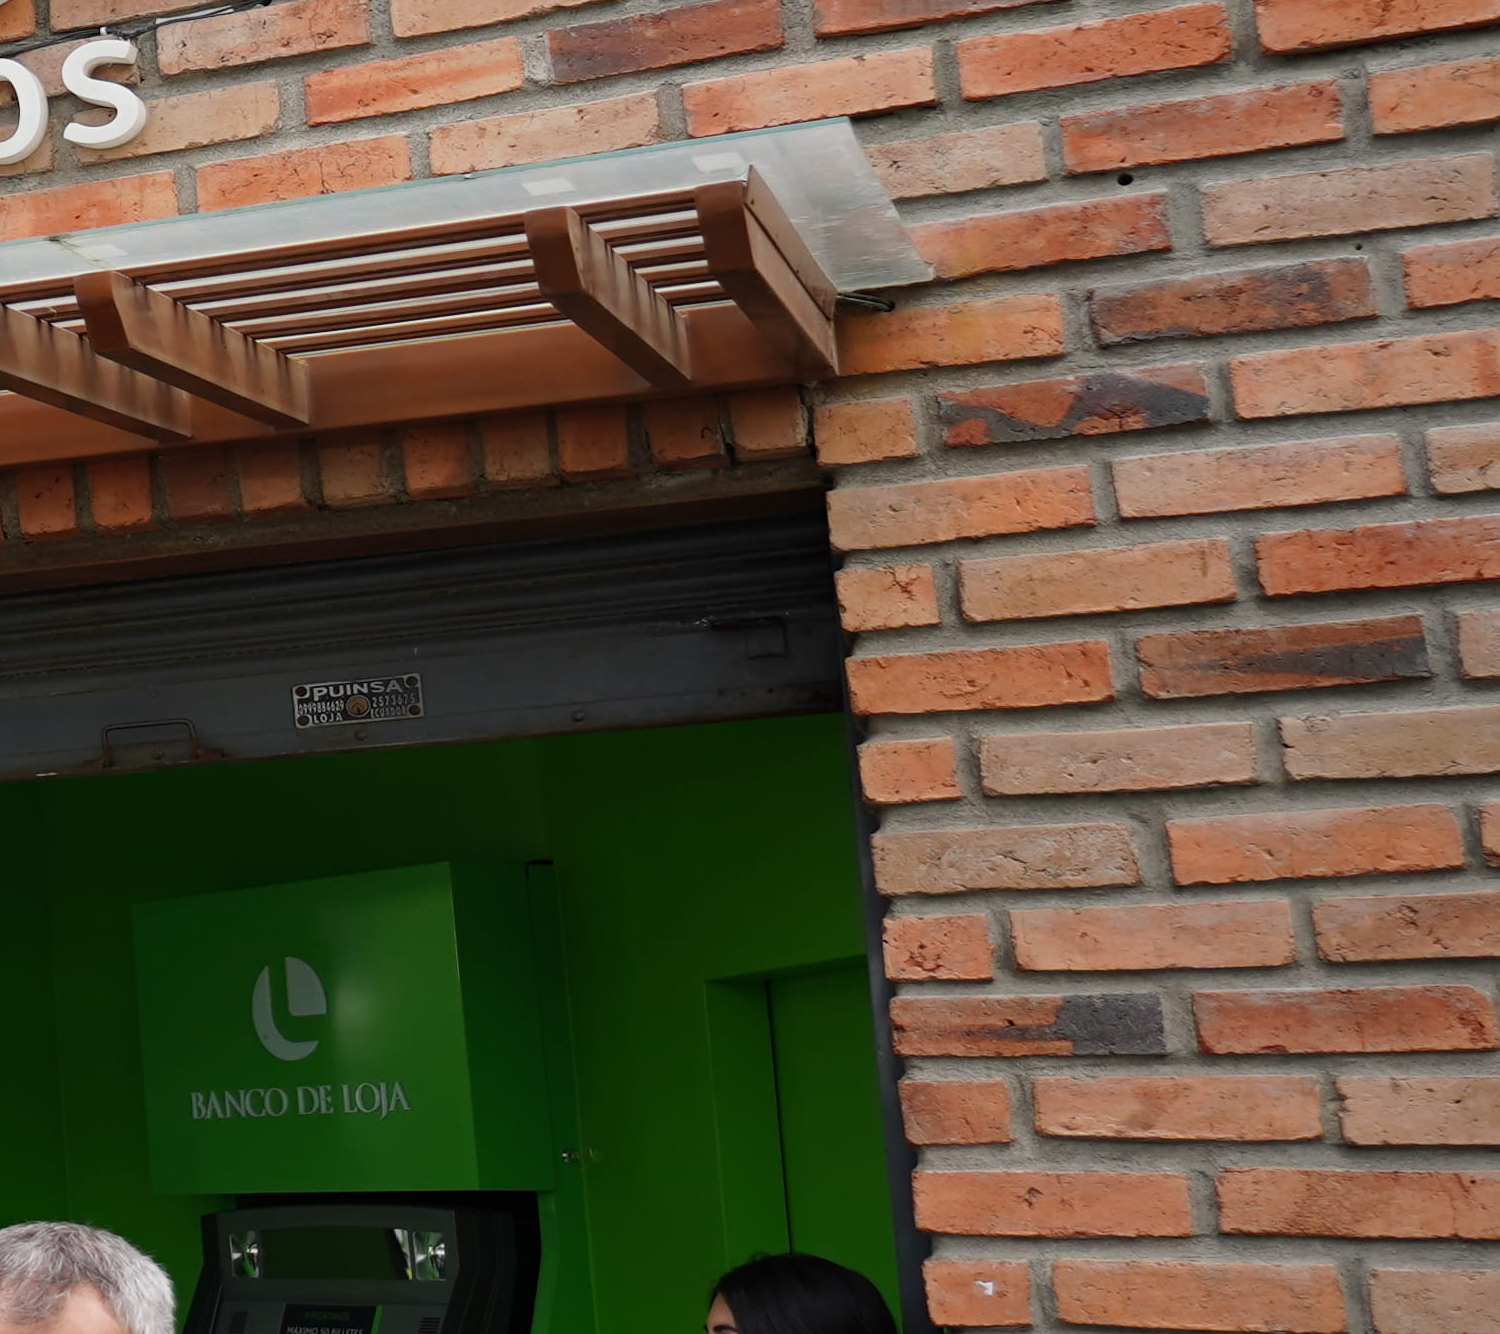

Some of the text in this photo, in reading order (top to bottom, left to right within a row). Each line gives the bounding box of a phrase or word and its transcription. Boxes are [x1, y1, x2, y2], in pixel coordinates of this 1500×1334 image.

[313, 679, 404, 702] PUINSA
[312, 713, 344, 724] LOJA
[190, 1081, 411, 1120] BANCO DE LOJA
